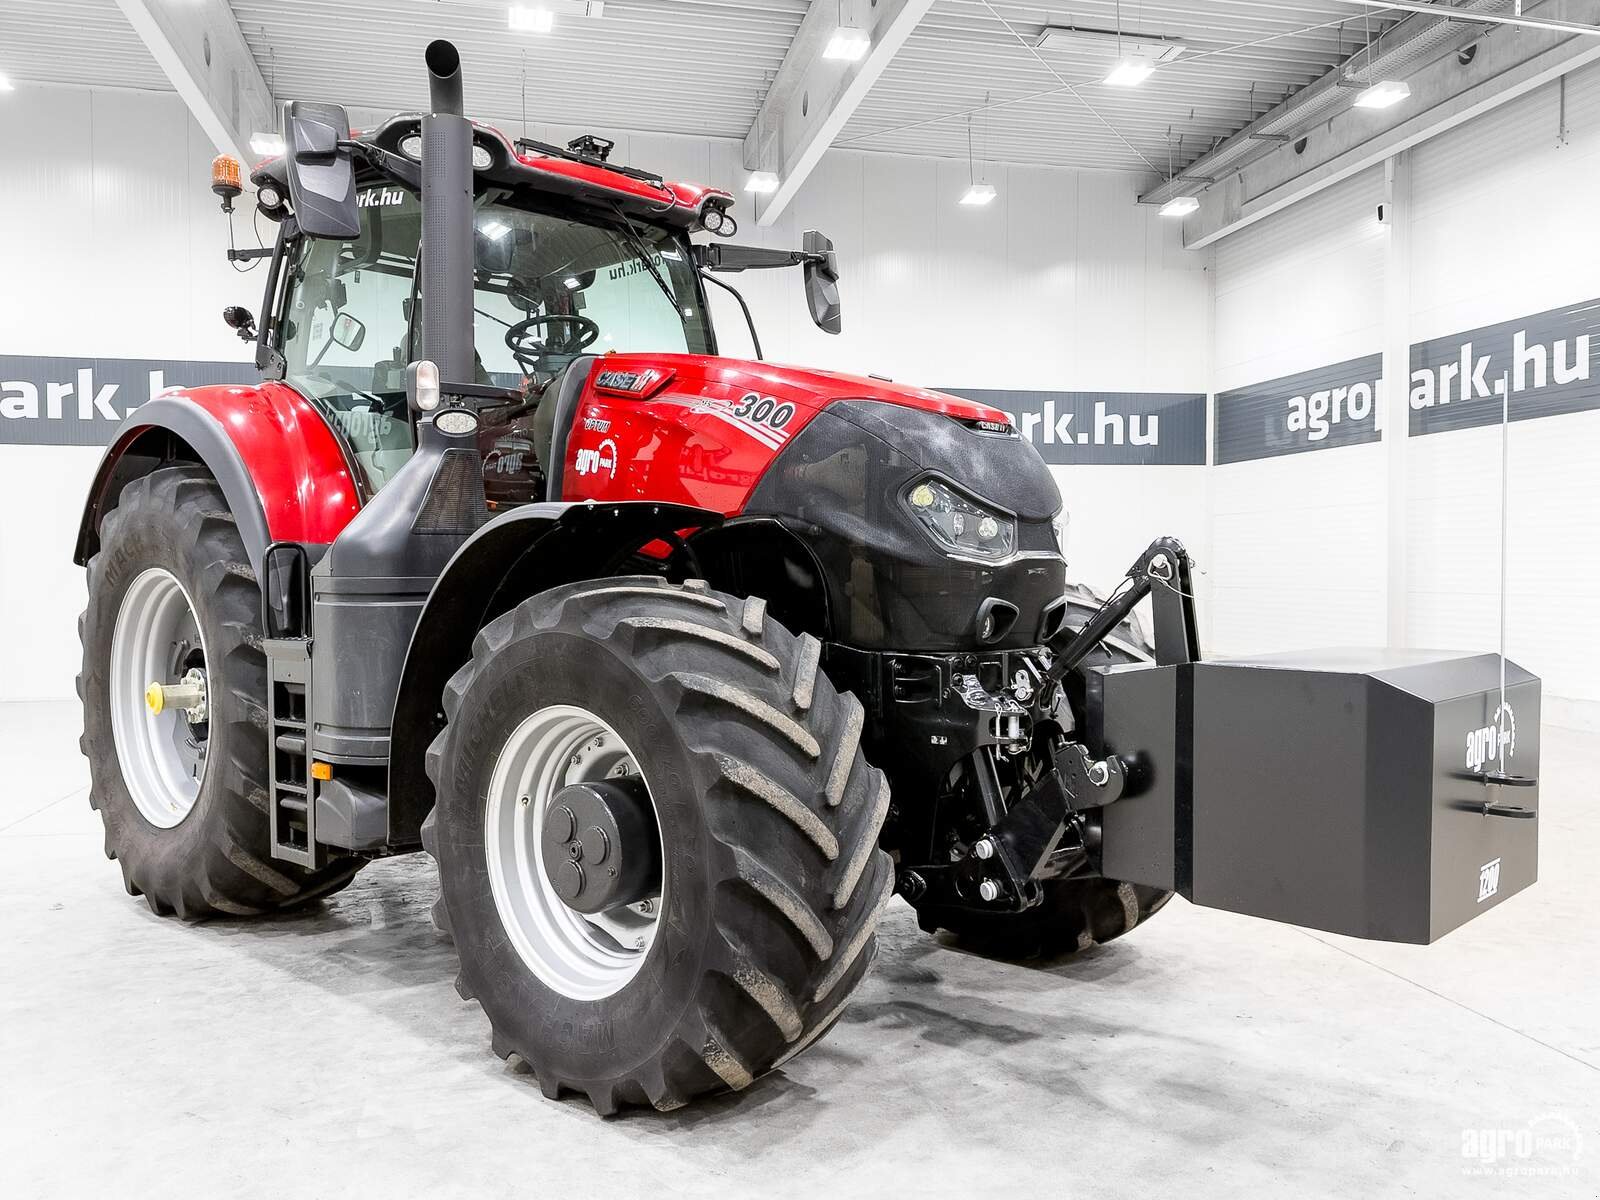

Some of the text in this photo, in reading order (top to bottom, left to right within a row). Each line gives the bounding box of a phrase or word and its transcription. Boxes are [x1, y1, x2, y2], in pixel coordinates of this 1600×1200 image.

[355, 187, 404, 208] rk.hu
[596, 370, 637, 391] CASE
[734, 393, 795, 430] 300
[584, 418, 611, 434] OPTUM
[575, 448, 600, 476] agro
[1466, 724, 1497, 773] agro
[1479, 861, 1500, 898] 1200
